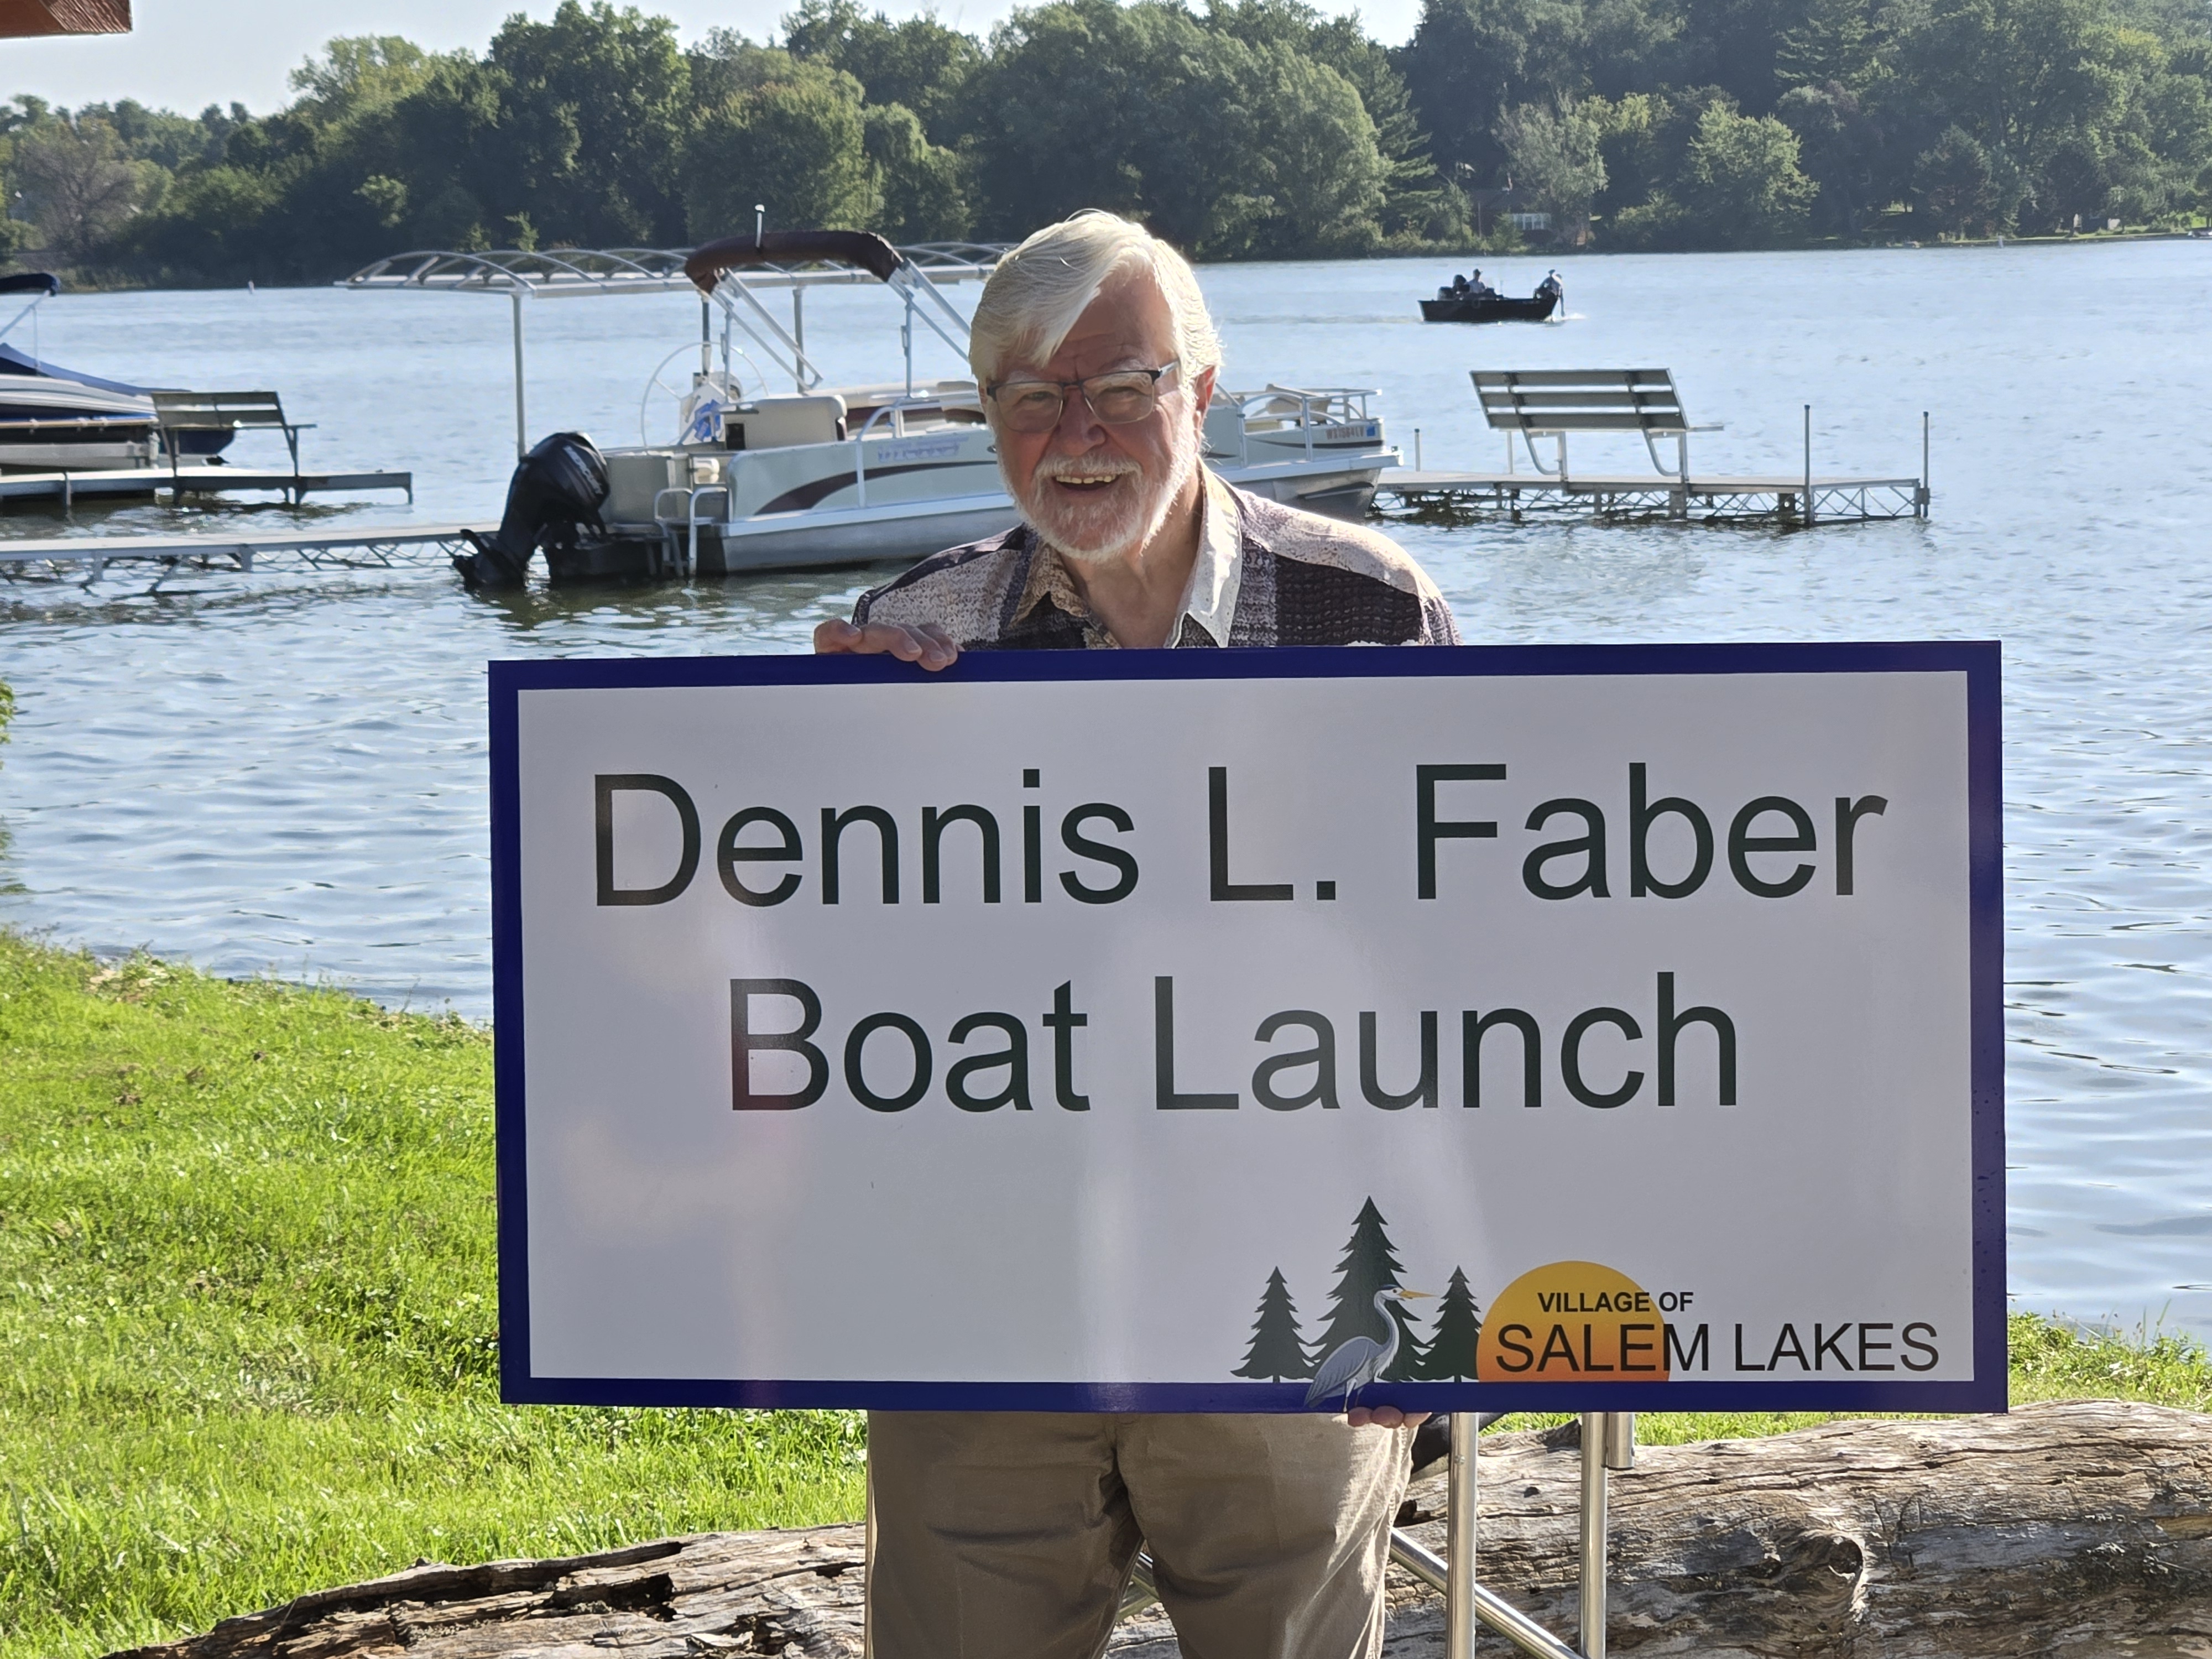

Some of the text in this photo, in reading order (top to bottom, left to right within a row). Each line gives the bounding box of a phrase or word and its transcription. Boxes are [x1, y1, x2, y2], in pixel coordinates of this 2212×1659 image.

[594, 762, 1888, 907] Dennis L. Faber
[730, 971, 1736, 1113] Boat Launch
[1495, 1322, 1939, 1373] SALEM LAKES
[1537, 1291, 1694, 1313] VILLAGE OF
